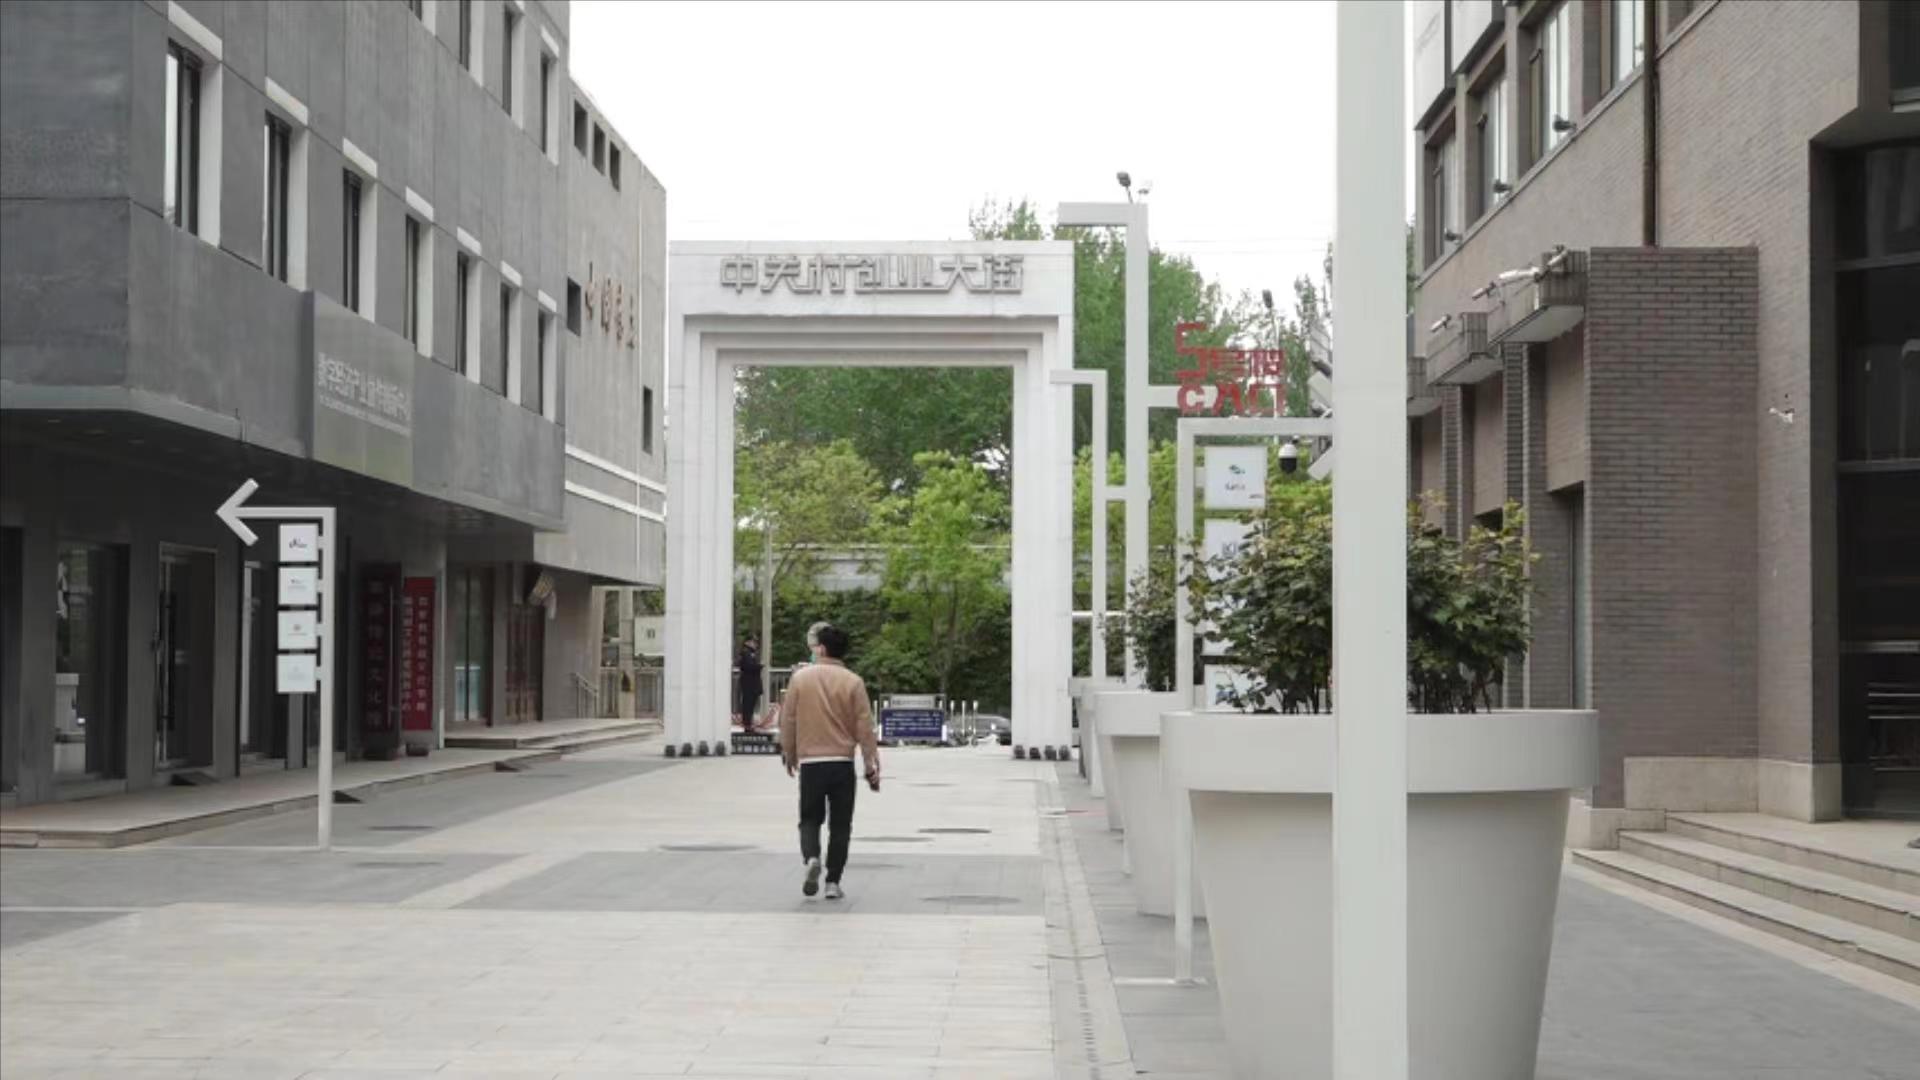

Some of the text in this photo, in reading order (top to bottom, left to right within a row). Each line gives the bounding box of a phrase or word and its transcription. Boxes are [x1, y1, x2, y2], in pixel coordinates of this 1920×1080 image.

[720, 254, 1024, 295] 中关村创业大街
